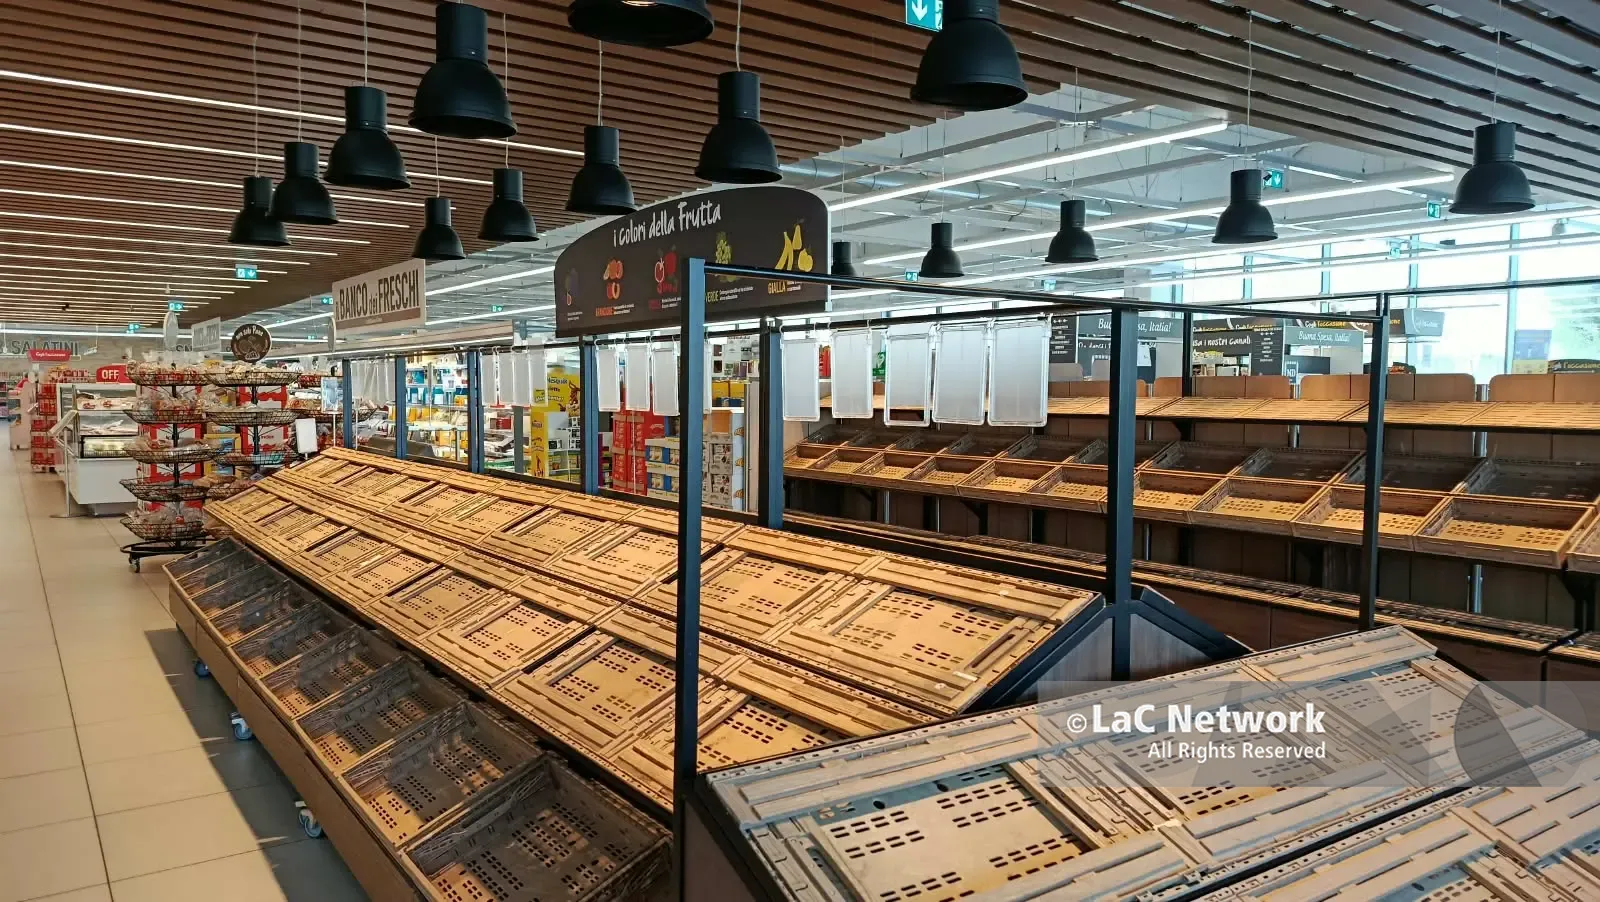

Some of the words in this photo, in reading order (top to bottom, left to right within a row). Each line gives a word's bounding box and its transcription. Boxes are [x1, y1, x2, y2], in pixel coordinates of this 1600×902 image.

[613, 229, 617, 248] i
[648, 209, 675, 239] della
[677, 199, 722, 232] Frutta
[767, 280, 786, 294] GIALLA
[340, 282, 368, 320] BANCO
[369, 293, 378, 315] dei
[378, 269, 420, 313] FRESCHI
[1149, 321, 1172, 332] Italia!
[1208, 337, 1228, 346] nostri
[1229, 335, 1251, 345] canali
[1299, 330, 1317, 341] Buona
[12, 340, 79, 355] SALATINI
